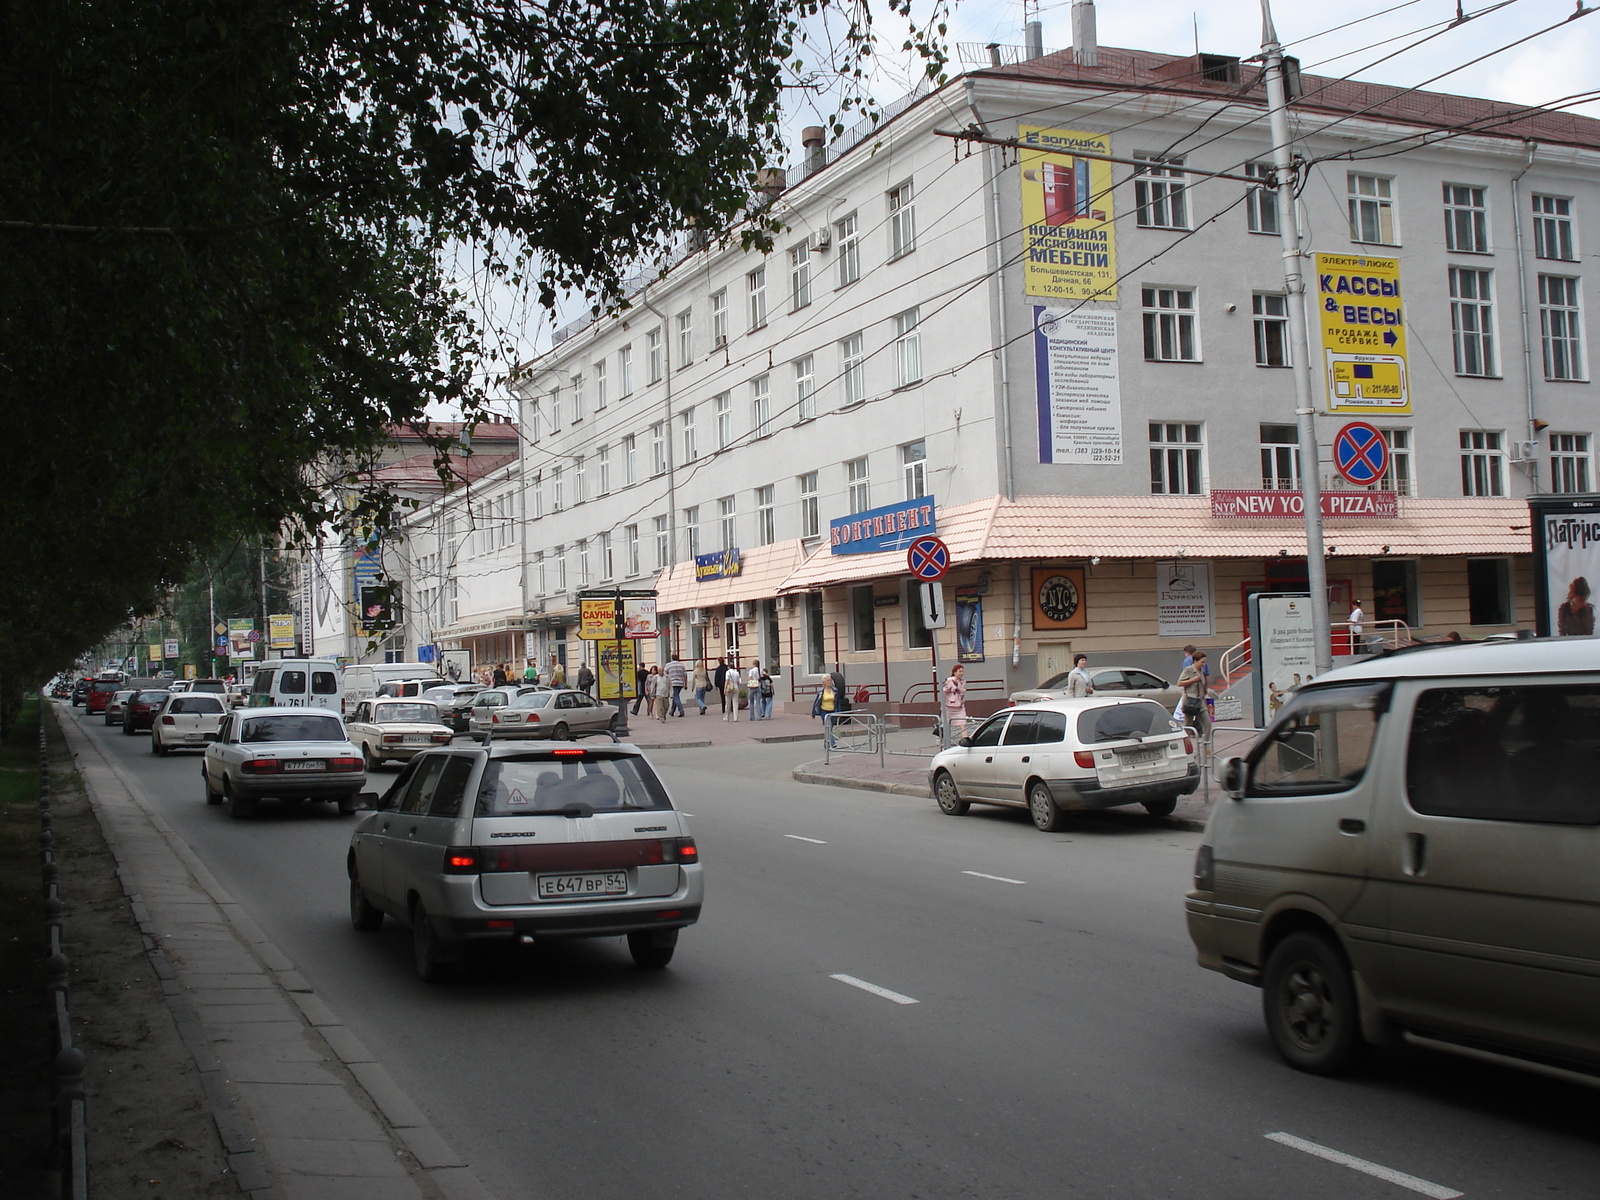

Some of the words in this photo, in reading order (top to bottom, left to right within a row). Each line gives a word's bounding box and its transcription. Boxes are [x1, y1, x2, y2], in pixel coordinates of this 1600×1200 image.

[1041, 135, 1105, 148] ЗОЛУШКА
[1029, 225, 1107, 241] НОВЕЙШАЯ
[1029, 237, 1107, 252] ЭКСПОЗИЦИЯ
[1030, 248, 1108, 268] МЕБЕЛИ
[1030, 266, 1096, 278] Большевистская,
[1097, 271, 1112, 279] 131,
[1052, 276, 1081, 285] Дачная,
[1320, 274, 1400, 298] КАССЫ
[1043, 286, 1076, 295] 12-00-15,
[1324, 297, 1340, 312] &
[1343, 305, 1402, 326] ВЕСЫ
[1328, 328, 1378, 338] ПРОДАЖА
[1338, 336, 1379, 346] СЕРВИС
[1215, 502, 1236, 512] NYP
[1236, 496, 1276, 513] NEW
[1280, 496, 1325, 513] YOK
[1331, 496, 1375, 513] PIZZA
[1376, 503, 1395, 512] NYP
[831, 505, 931, 547] КОНТИНЕНТ
[1041, 579, 1053, 597] NEW
[1057, 578, 1077, 596] YORK
[1048, 587, 1070, 610] NYC
[583, 610, 614, 619] САУНЫ
[1042, 606, 1076, 620] COFFEE
[600, 653, 633, 661] ЗАПРАКА
